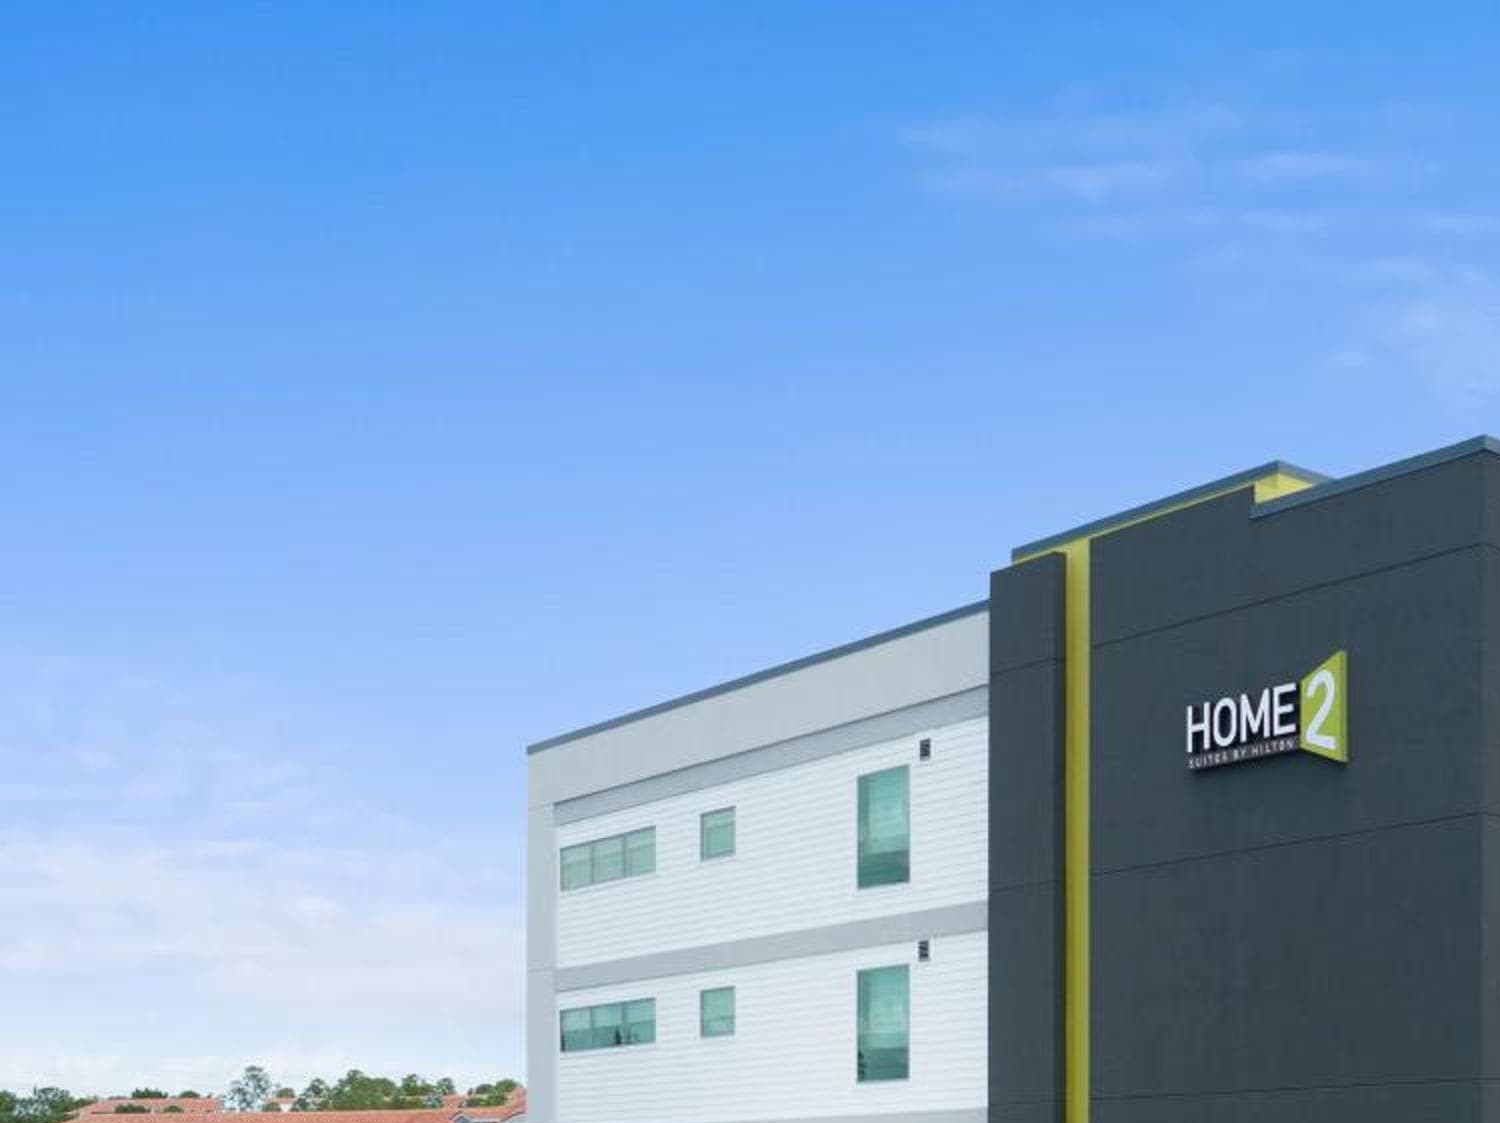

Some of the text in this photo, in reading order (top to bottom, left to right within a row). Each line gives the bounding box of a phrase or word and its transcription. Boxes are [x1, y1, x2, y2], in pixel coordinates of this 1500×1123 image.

[1186, 669, 1337, 753] HOME 2
[1189, 739, 1295, 769] SUITES BY HILTON
